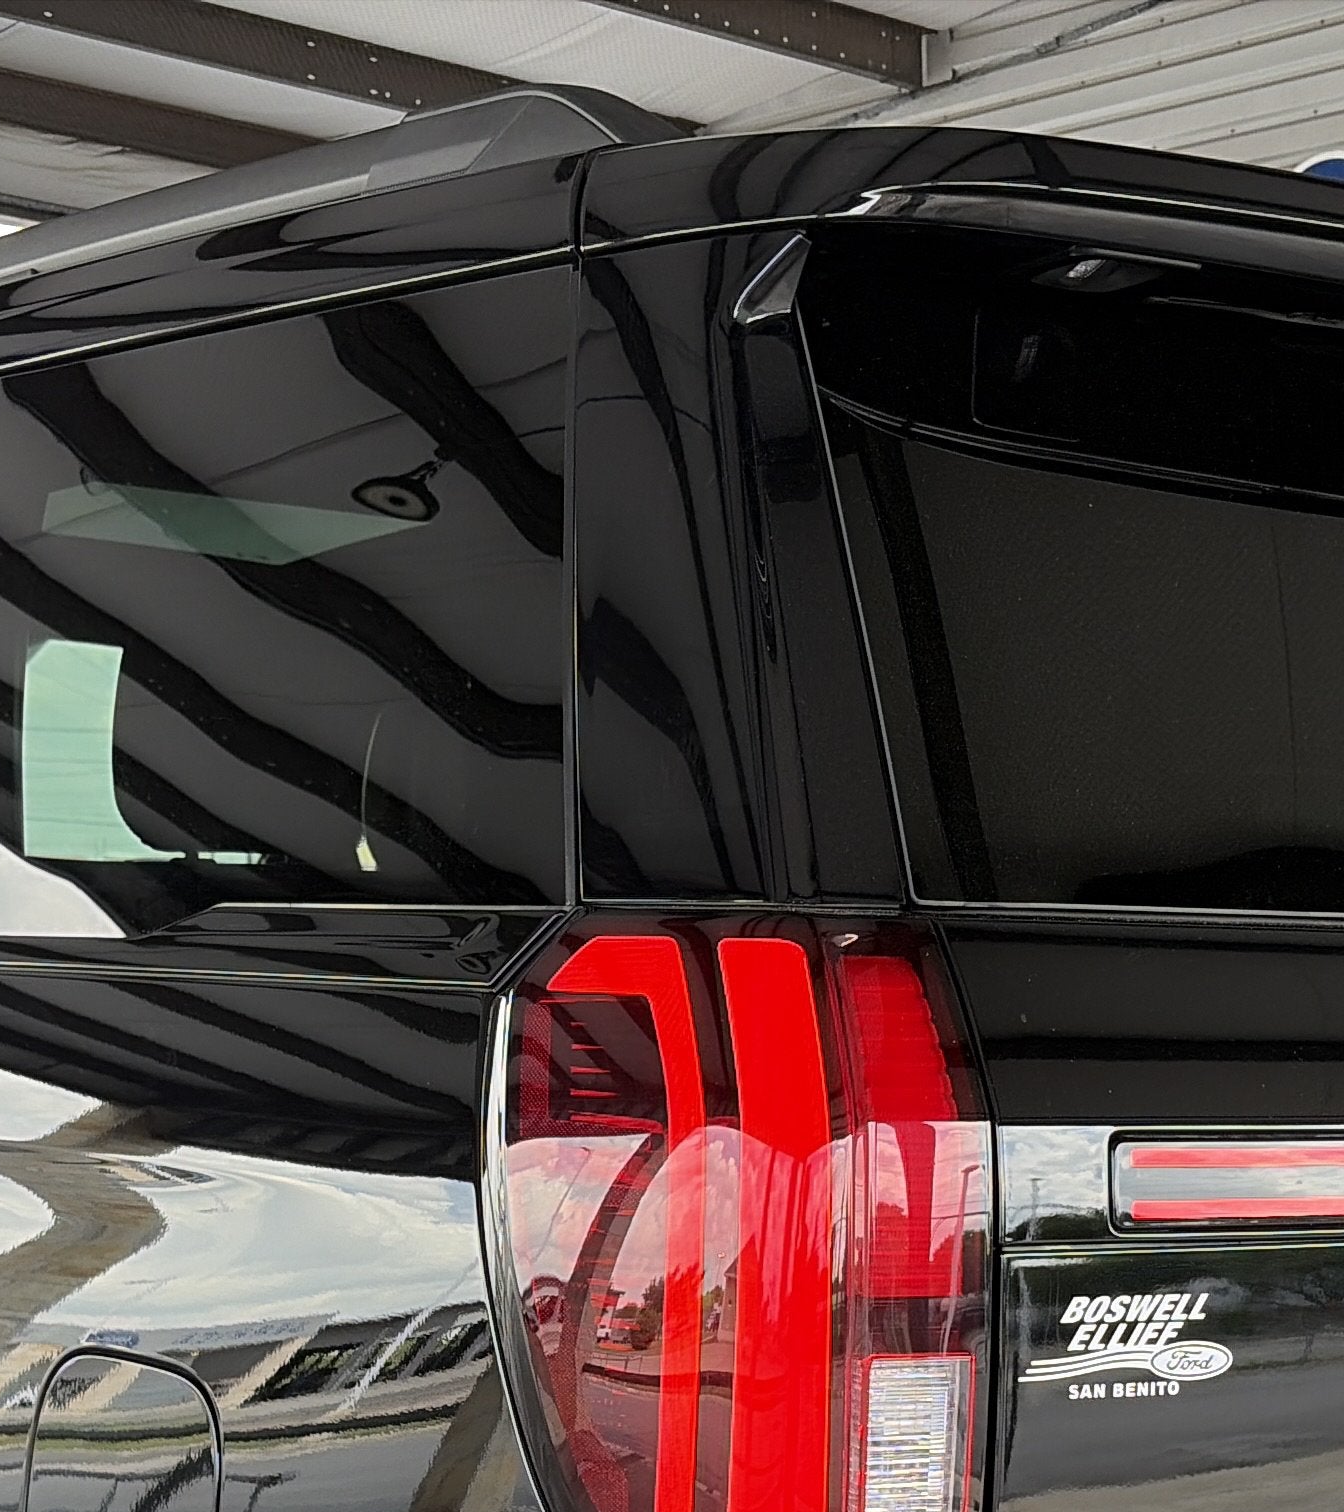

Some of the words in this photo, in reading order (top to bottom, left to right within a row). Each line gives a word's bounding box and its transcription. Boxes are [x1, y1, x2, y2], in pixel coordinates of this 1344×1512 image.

[1059, 1292, 1210, 1324] BOSWELL
[1066, 1321, 1185, 1352] ELLIFF
[1166, 1350, 1214, 1371] Ford
[1068, 1382, 1107, 1400] SAN
[1112, 1380, 1180, 1398] BENITO
